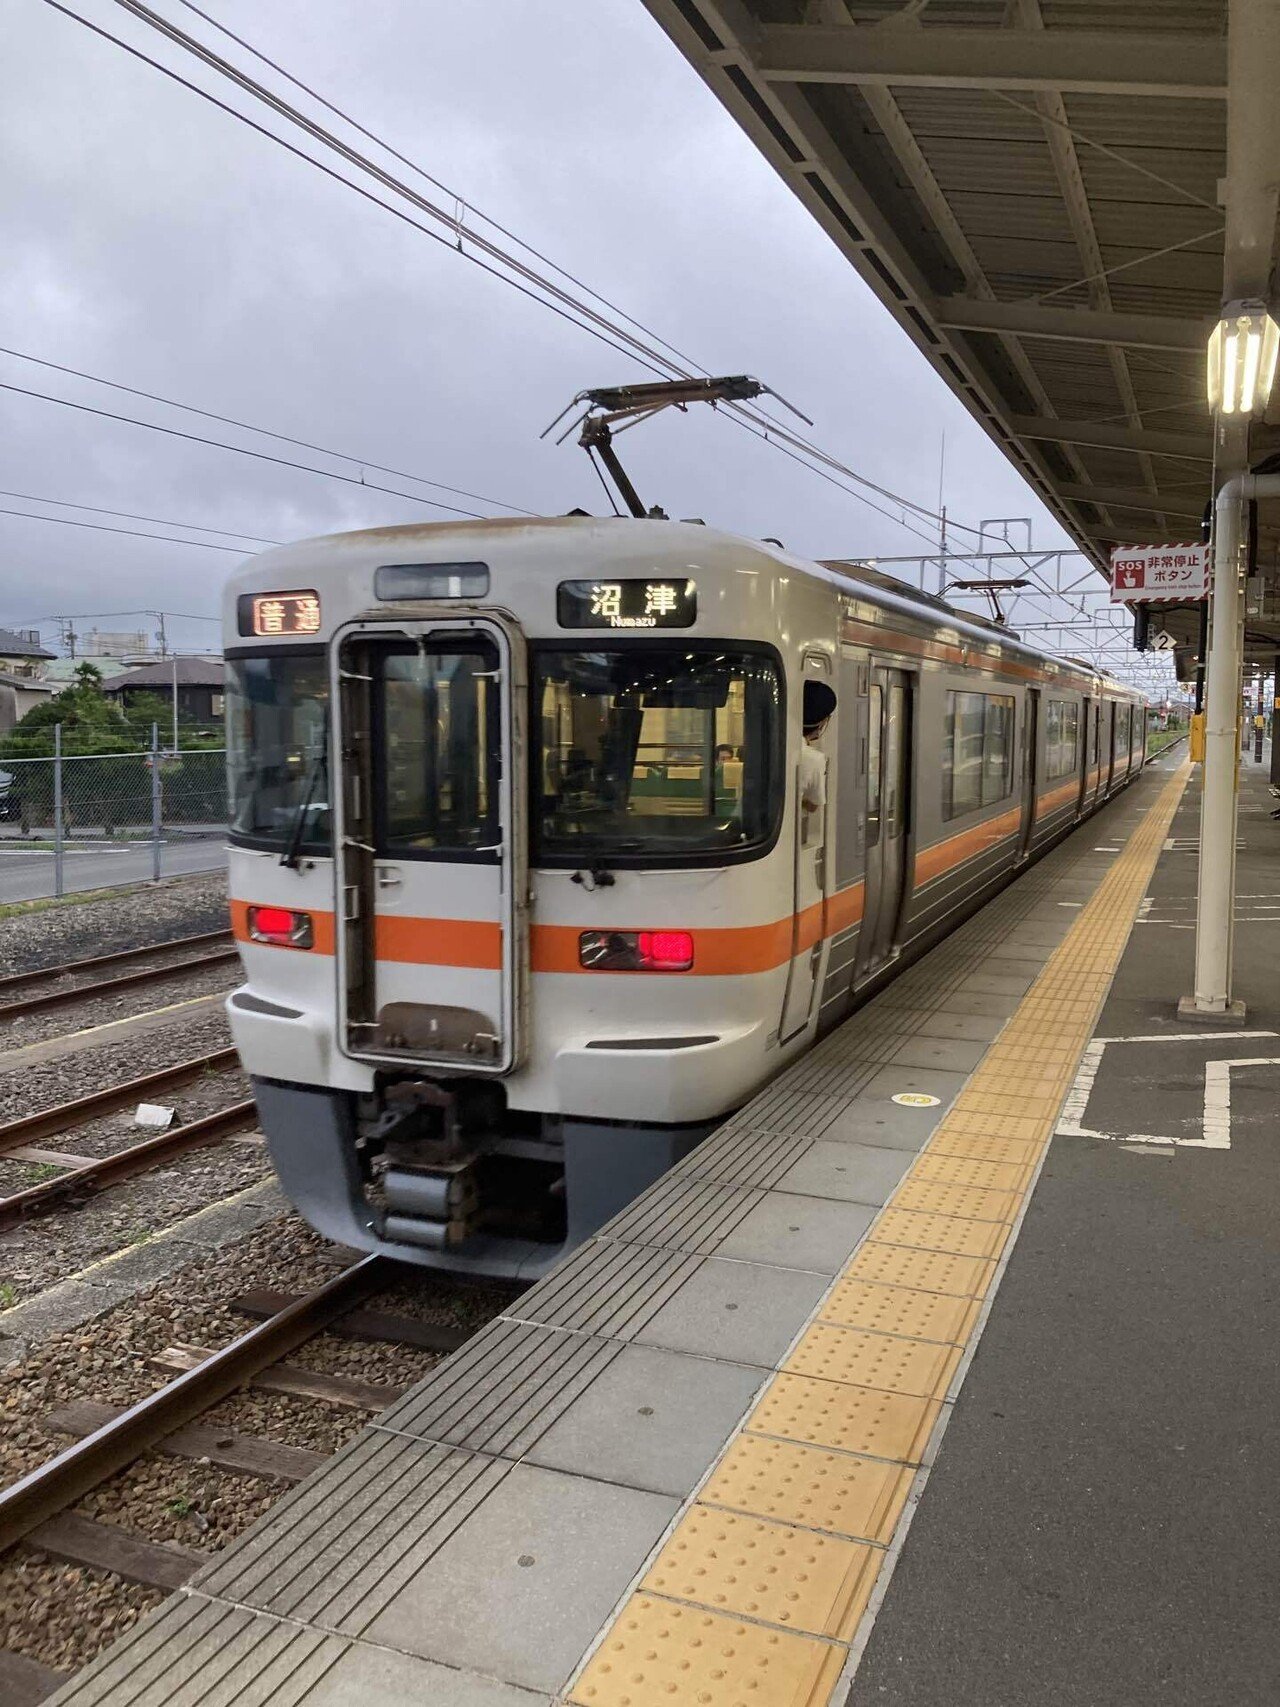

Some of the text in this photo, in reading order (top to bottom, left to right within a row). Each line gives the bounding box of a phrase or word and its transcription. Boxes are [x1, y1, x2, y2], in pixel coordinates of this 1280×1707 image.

[1118, 561, 1142, 571] SOS
[1148, 555, 1199, 568] 非常停止
[1154, 570, 1192, 582] ボタン
[590, 585, 676, 615] 沼津
[260, 600, 320, 632] 普通
[610, 615, 656, 627] Numazu
[1158, 635, 1169, 650] 2
